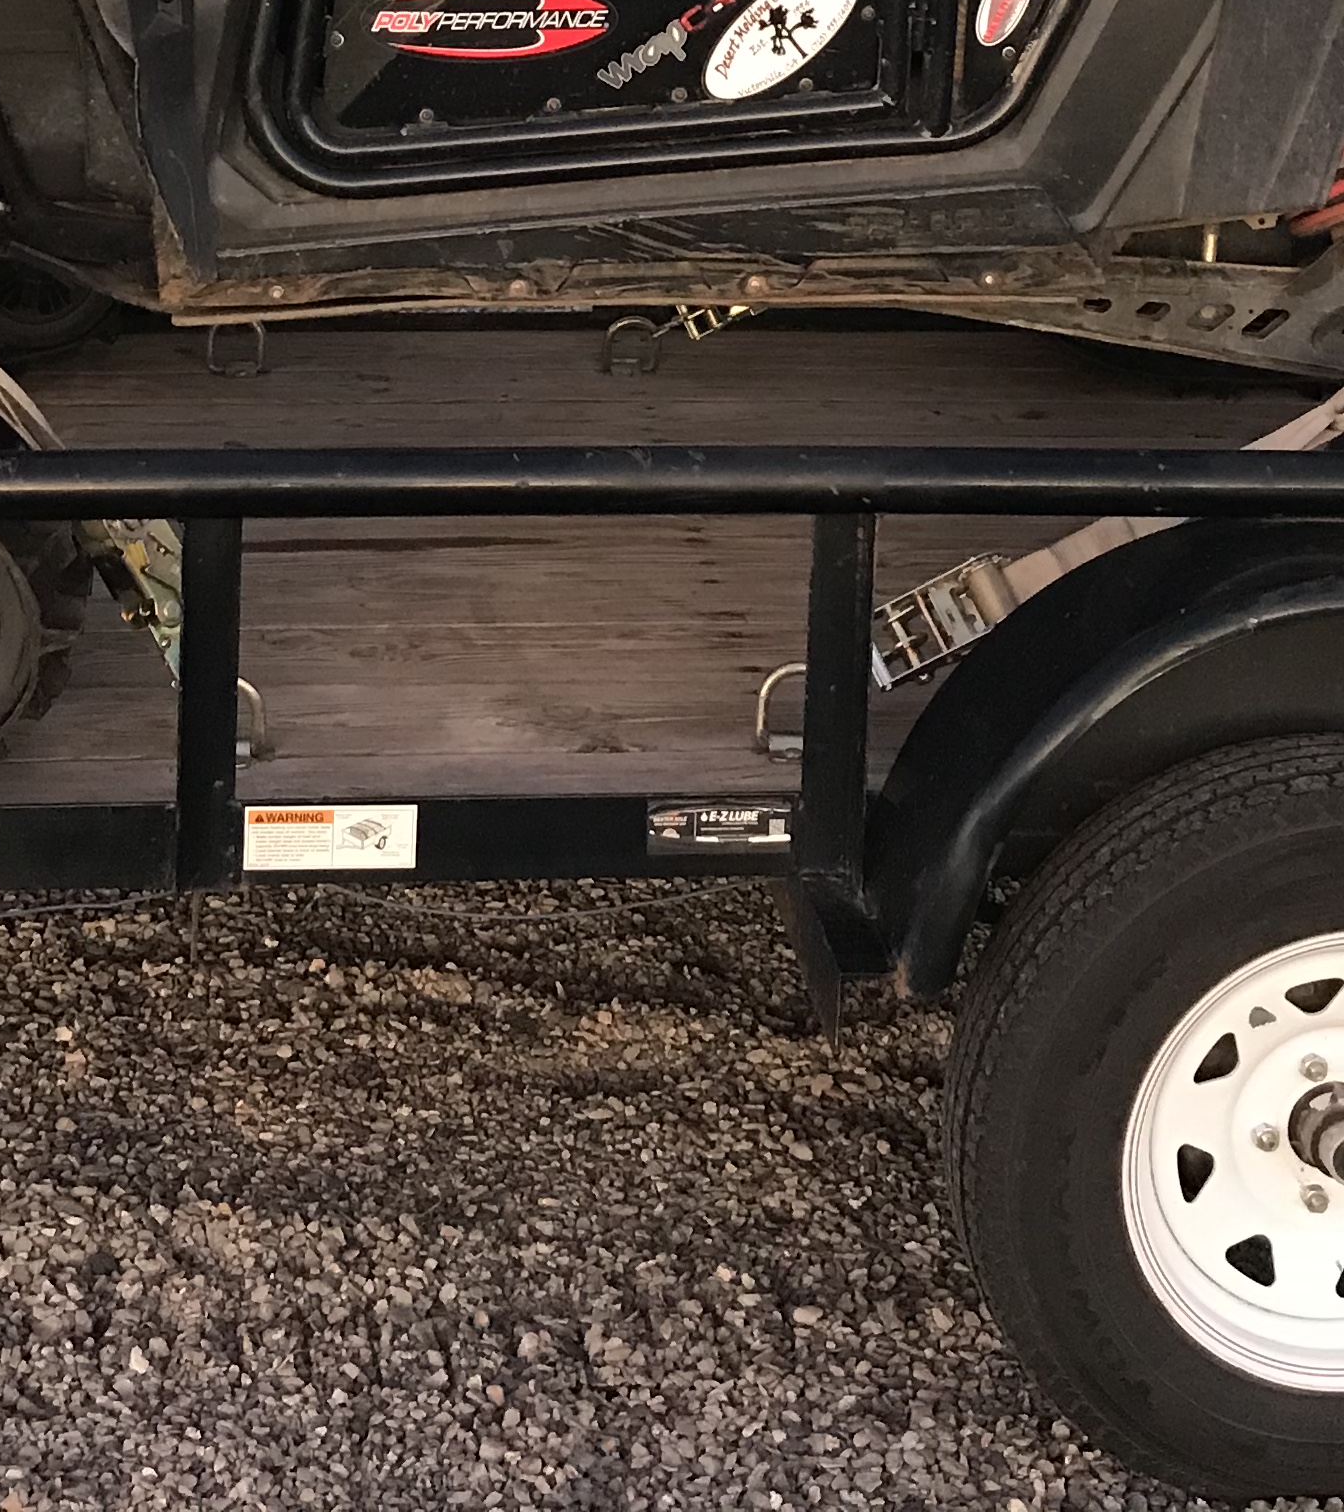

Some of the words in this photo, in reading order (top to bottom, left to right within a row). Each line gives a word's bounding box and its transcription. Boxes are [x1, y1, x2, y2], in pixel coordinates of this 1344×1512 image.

[714, 37, 740, 80] Desert
[734, 0, 772, 42] Molding
[265, 812, 324, 823] WARNING
